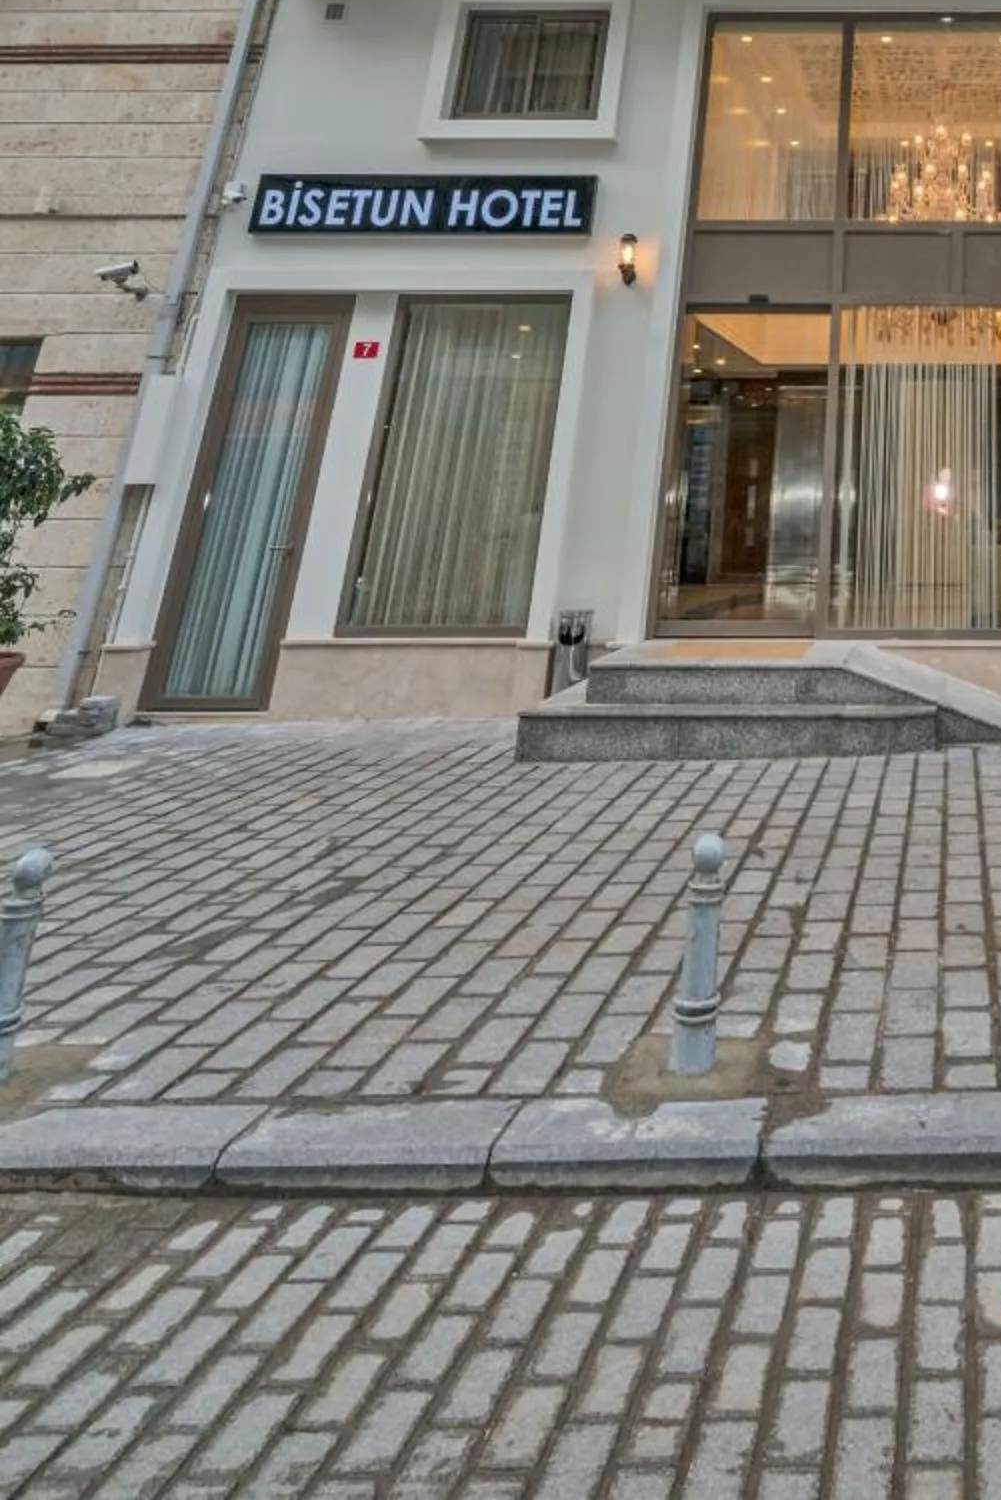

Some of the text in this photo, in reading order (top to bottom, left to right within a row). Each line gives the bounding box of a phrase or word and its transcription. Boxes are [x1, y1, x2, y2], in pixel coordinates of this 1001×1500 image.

[258, 181, 582, 227] BİSETUN HOTEL
[362, 343, 372, 357] 7
